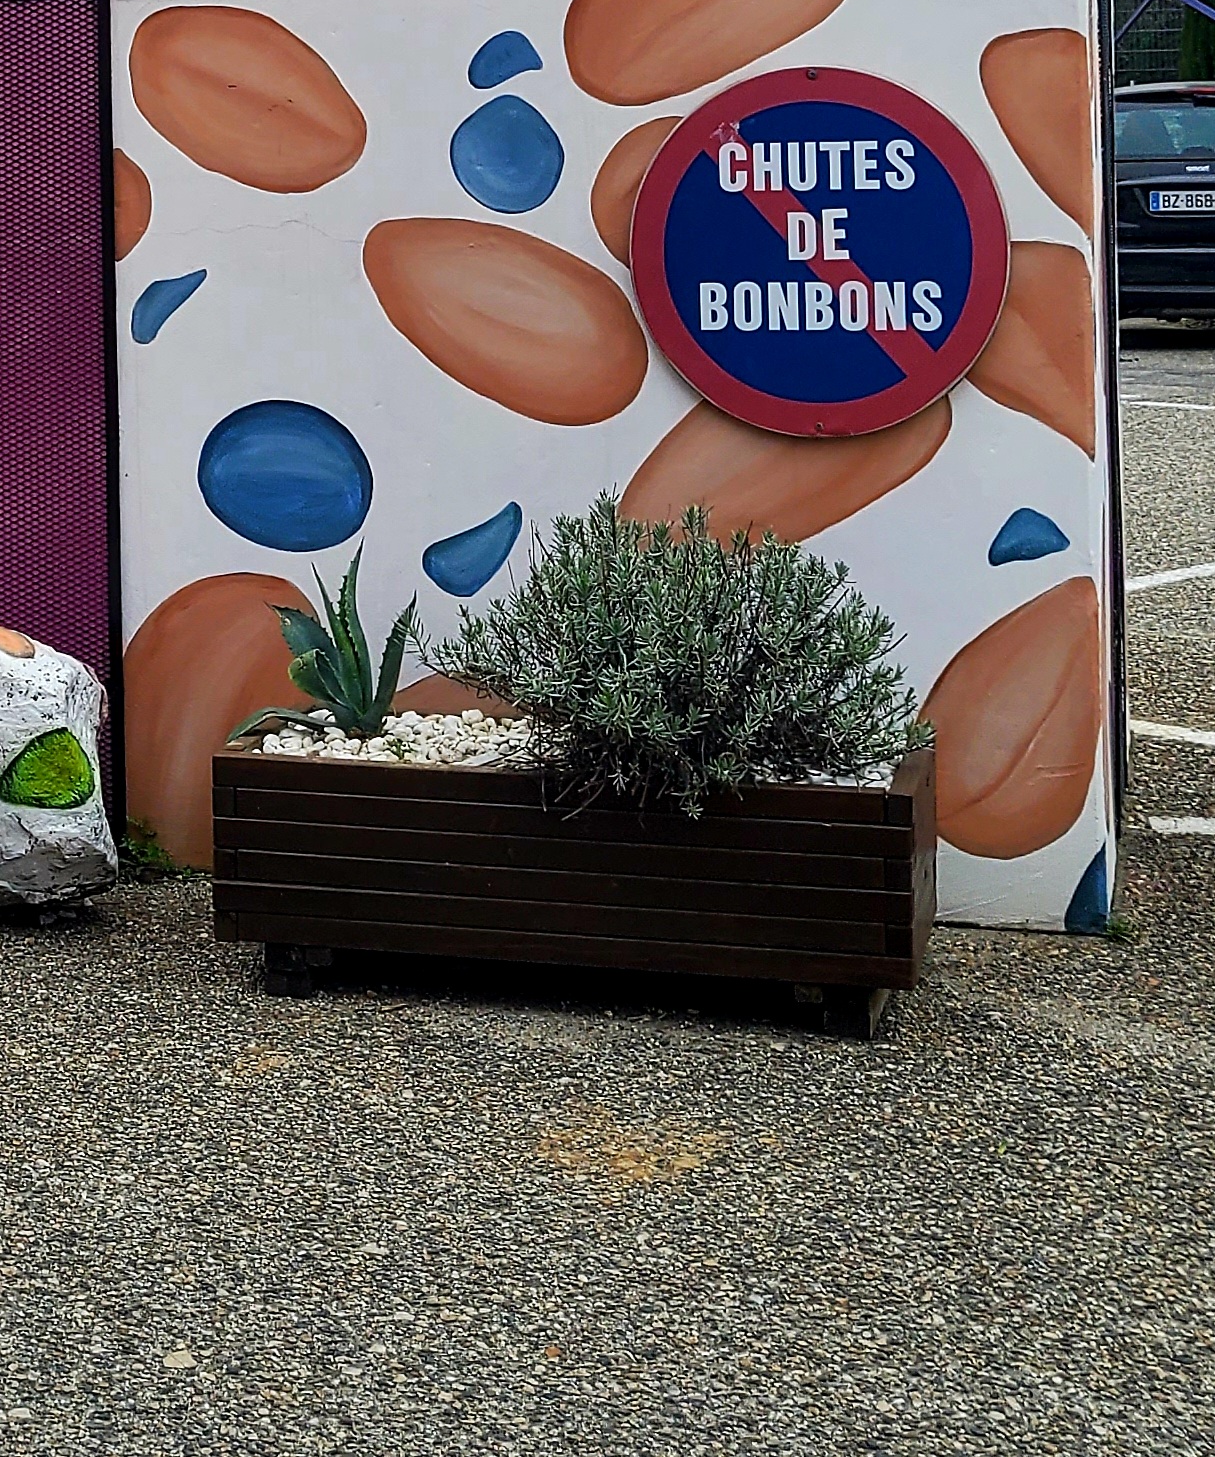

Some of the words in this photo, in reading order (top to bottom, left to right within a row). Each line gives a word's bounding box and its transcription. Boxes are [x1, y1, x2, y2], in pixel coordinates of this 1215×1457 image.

[718, 139, 916, 192] CHUTES
[787, 208, 850, 261] DE
[699, 280, 943, 332] BONBONS
